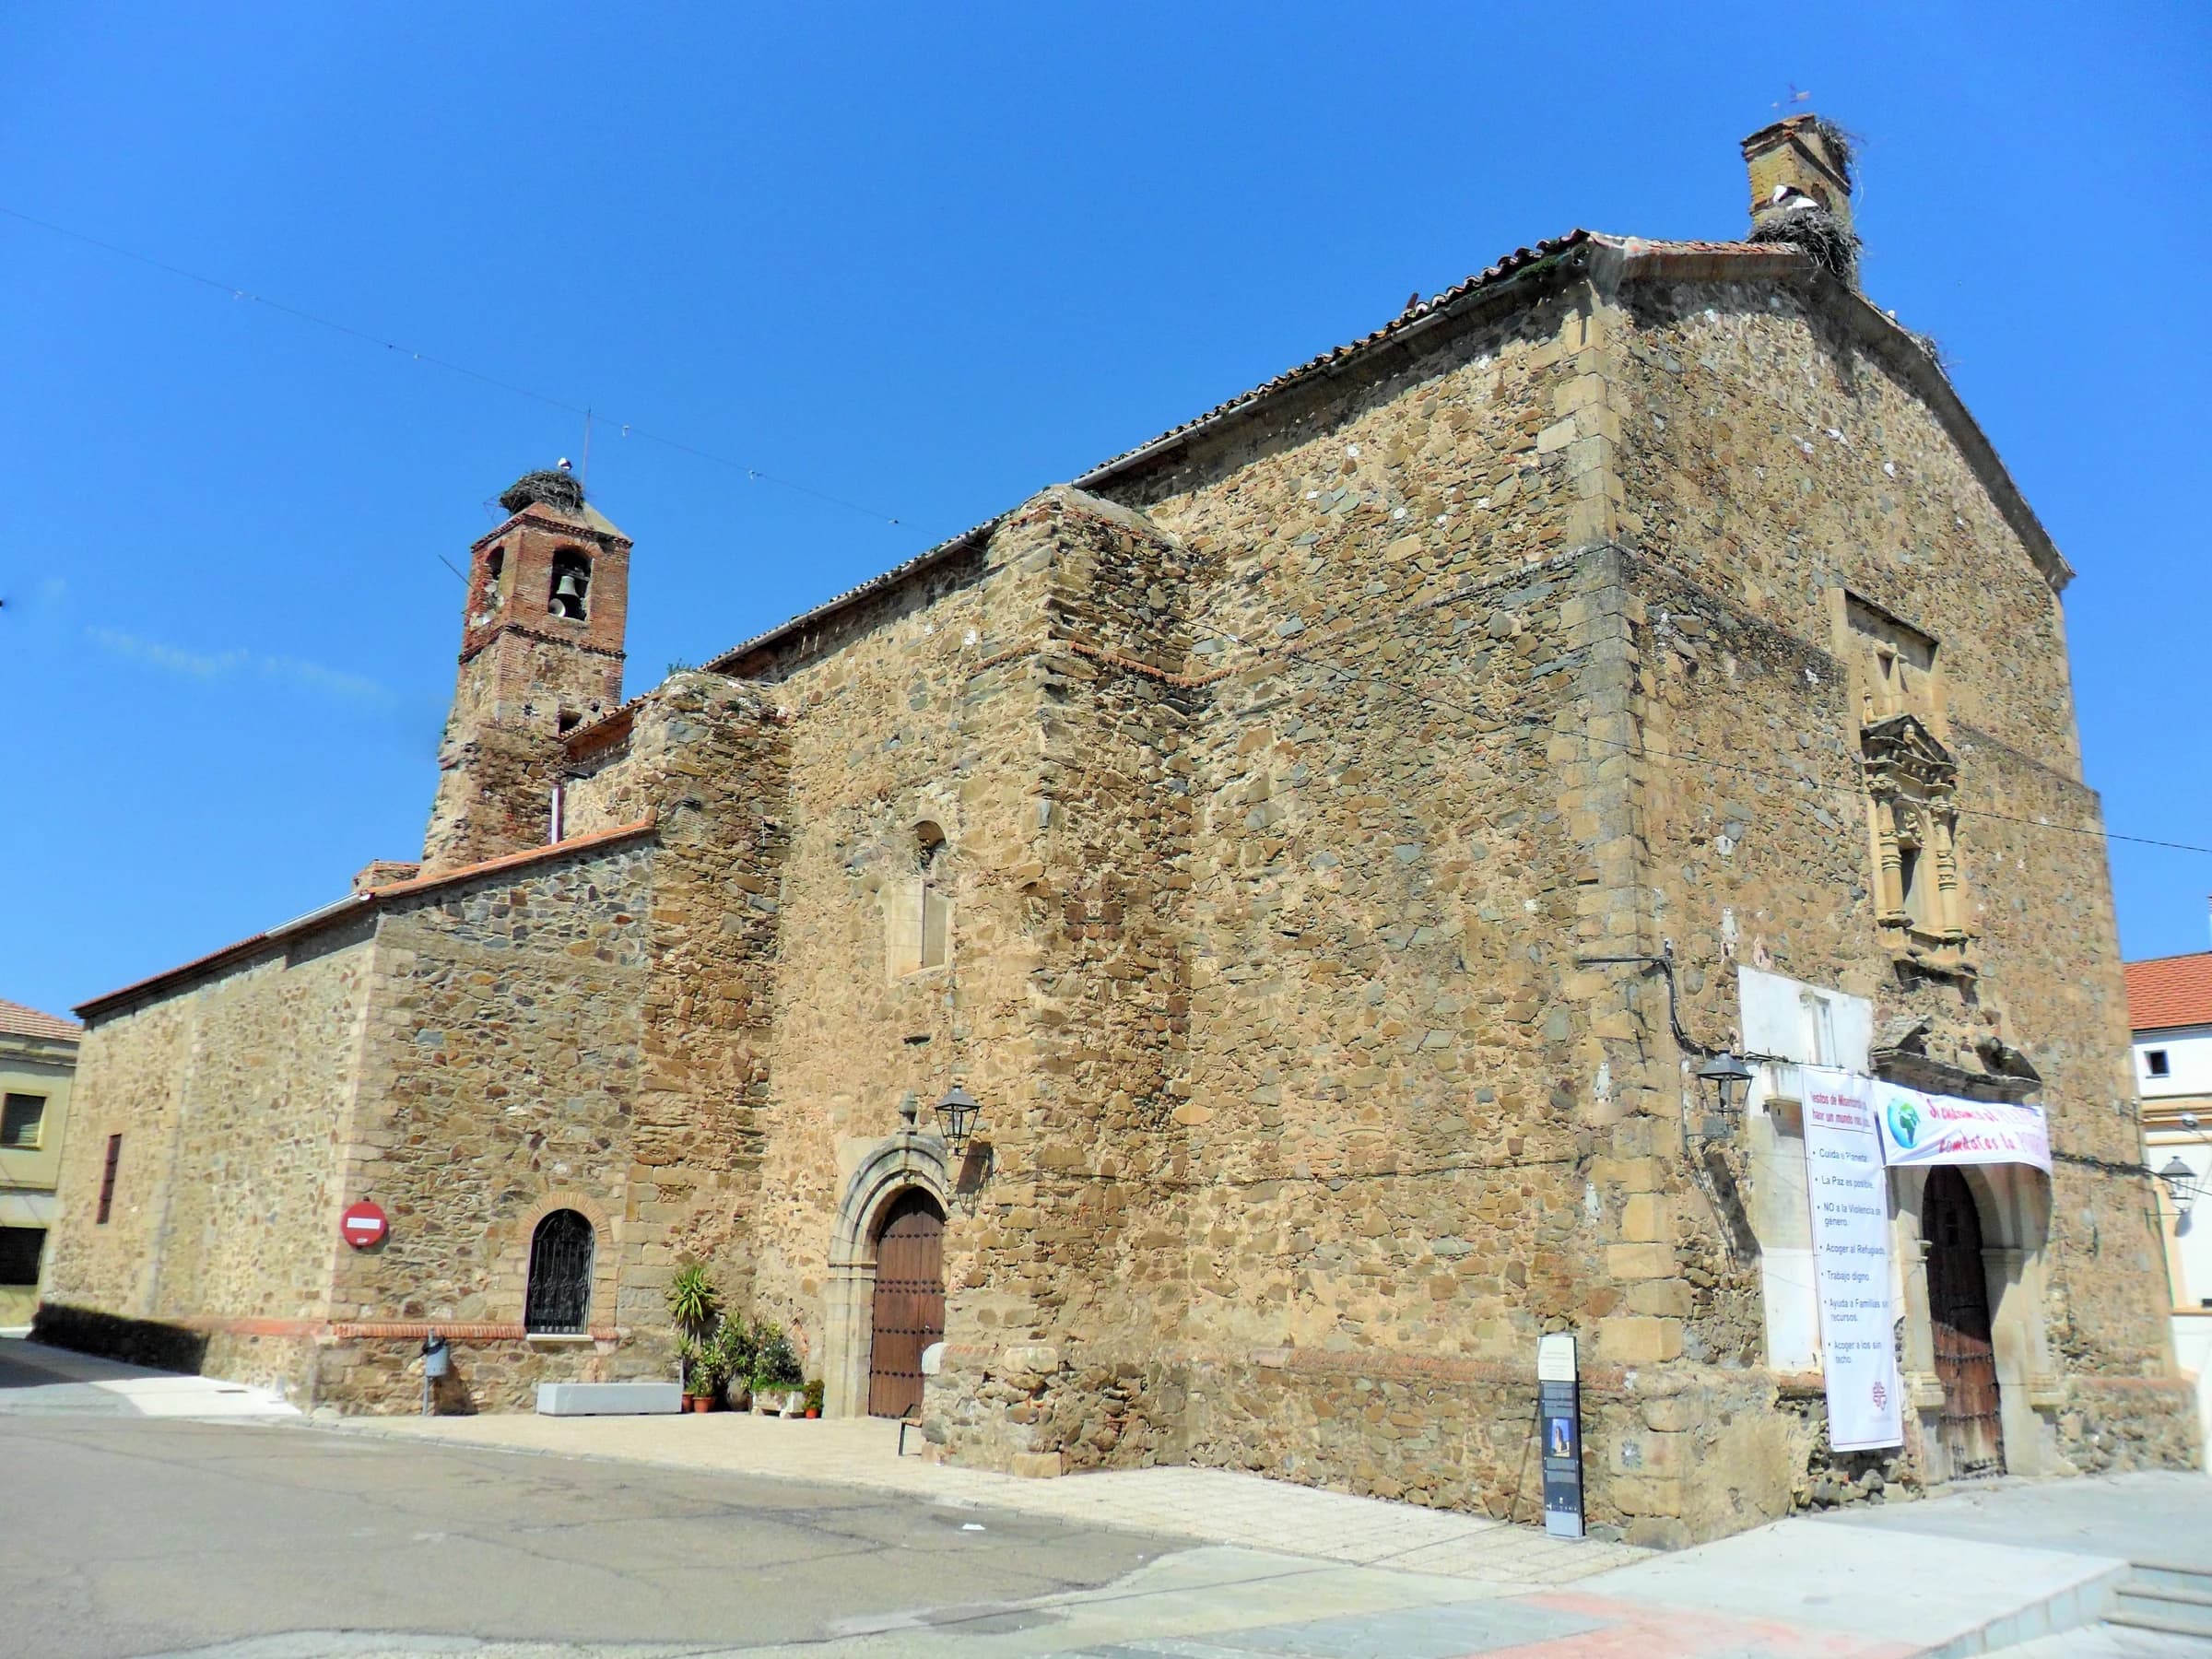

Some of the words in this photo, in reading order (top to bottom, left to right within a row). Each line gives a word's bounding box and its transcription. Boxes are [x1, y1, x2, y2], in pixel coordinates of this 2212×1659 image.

[1821, 1175, 1830, 1185] La
[1831, 1175, 1845, 1186] Paz
[1824, 1202, 1835, 1212] NO
[1826, 1242, 1849, 1255] Acoger
[1827, 1270, 1851, 1283] Trabajo
